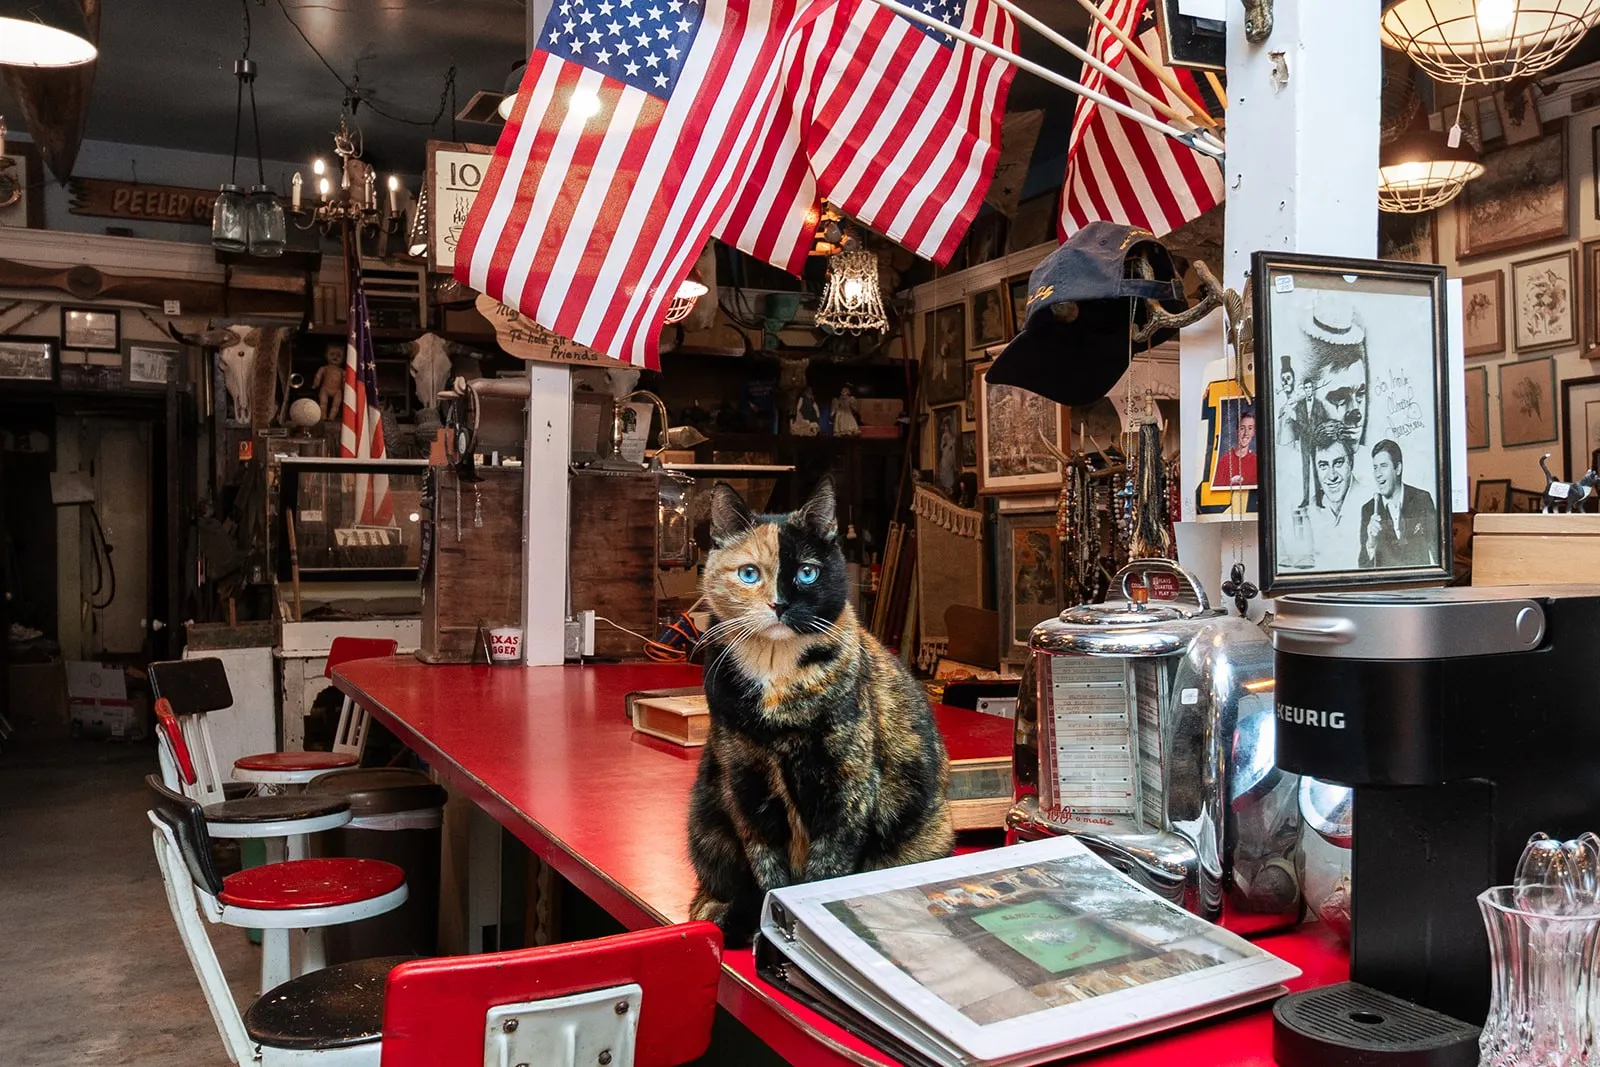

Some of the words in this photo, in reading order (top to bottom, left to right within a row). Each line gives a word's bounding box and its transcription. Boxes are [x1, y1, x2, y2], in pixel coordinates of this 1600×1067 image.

[450, 162, 482, 187] 10
[113, 189, 190, 217] PEELED
[550, 346, 599, 361] friends
[490, 635, 518, 645] EXAS
[493, 645, 516, 655] GGER
[1277, 702, 1346, 729] KEURIG
